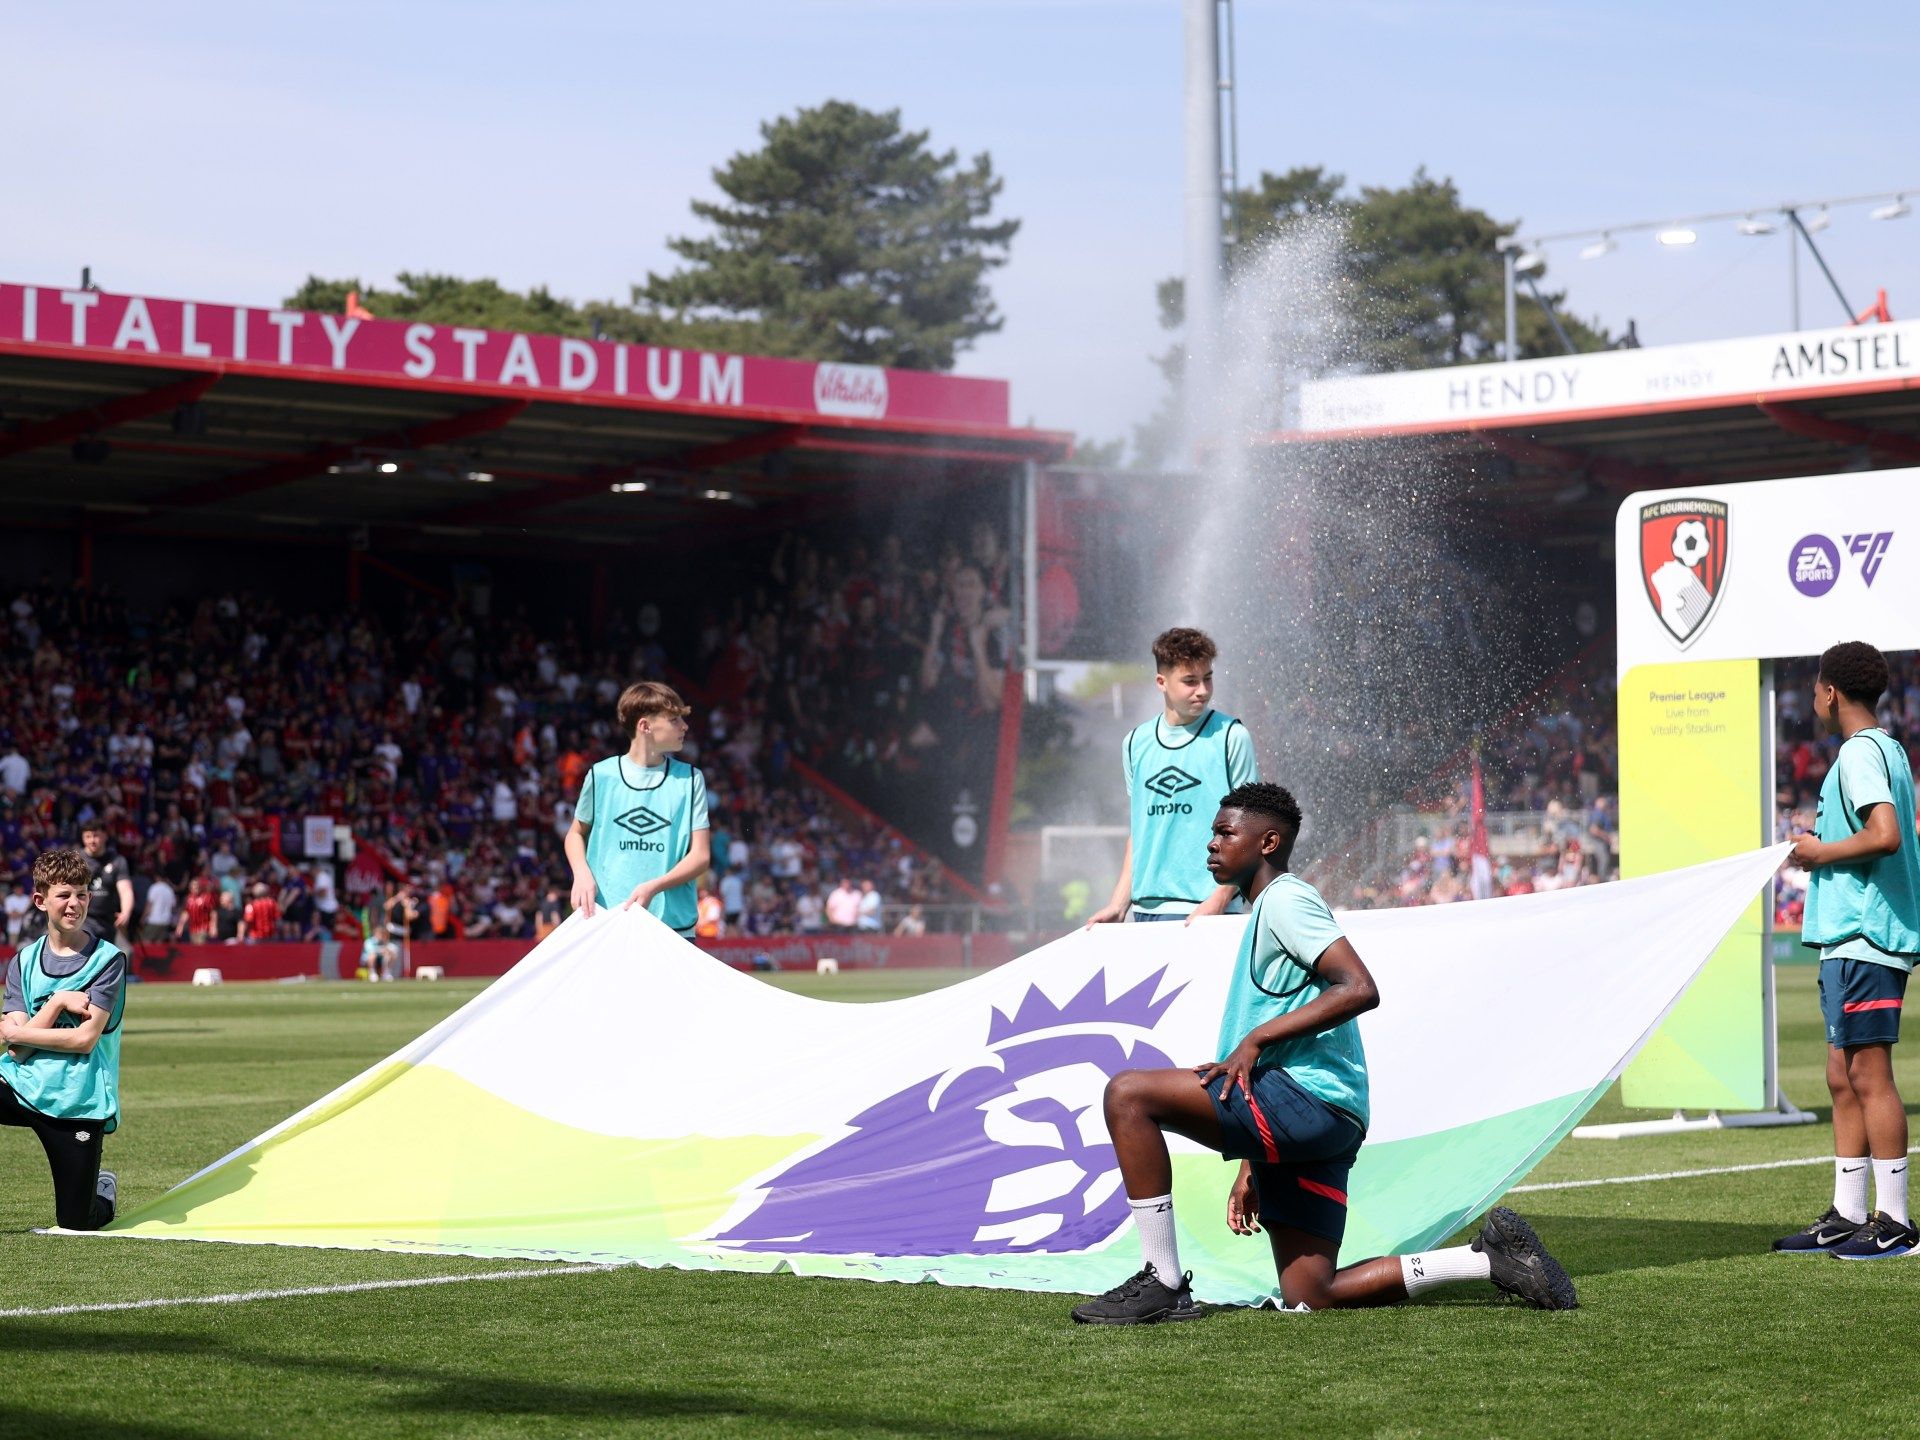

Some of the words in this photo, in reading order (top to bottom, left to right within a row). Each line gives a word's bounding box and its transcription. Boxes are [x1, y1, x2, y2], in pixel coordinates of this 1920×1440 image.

[404, 323, 744, 406] STADIUM
[1771, 331, 1911, 380] AMSTEL
[1448, 366, 1580, 411] HENDY
[1643, 506, 1660, 520] AFC
[1660, 501, 1726, 516] BOURNEMOUTH
[1796, 546, 1833, 570] EA
[1795, 568, 1835, 583] SPORTS
[1649, 690, 1685, 702] Premier
[1688, 690, 1726, 703] League
[1665, 708, 1684, 718] Live
[1686, 707, 1709, 717] from
[1650, 724, 1683, 736] Vitality
[1685, 722, 1726, 735] Stadium
[619, 838, 665, 853] umbro
[1411, 1257, 1425, 1278] 23
